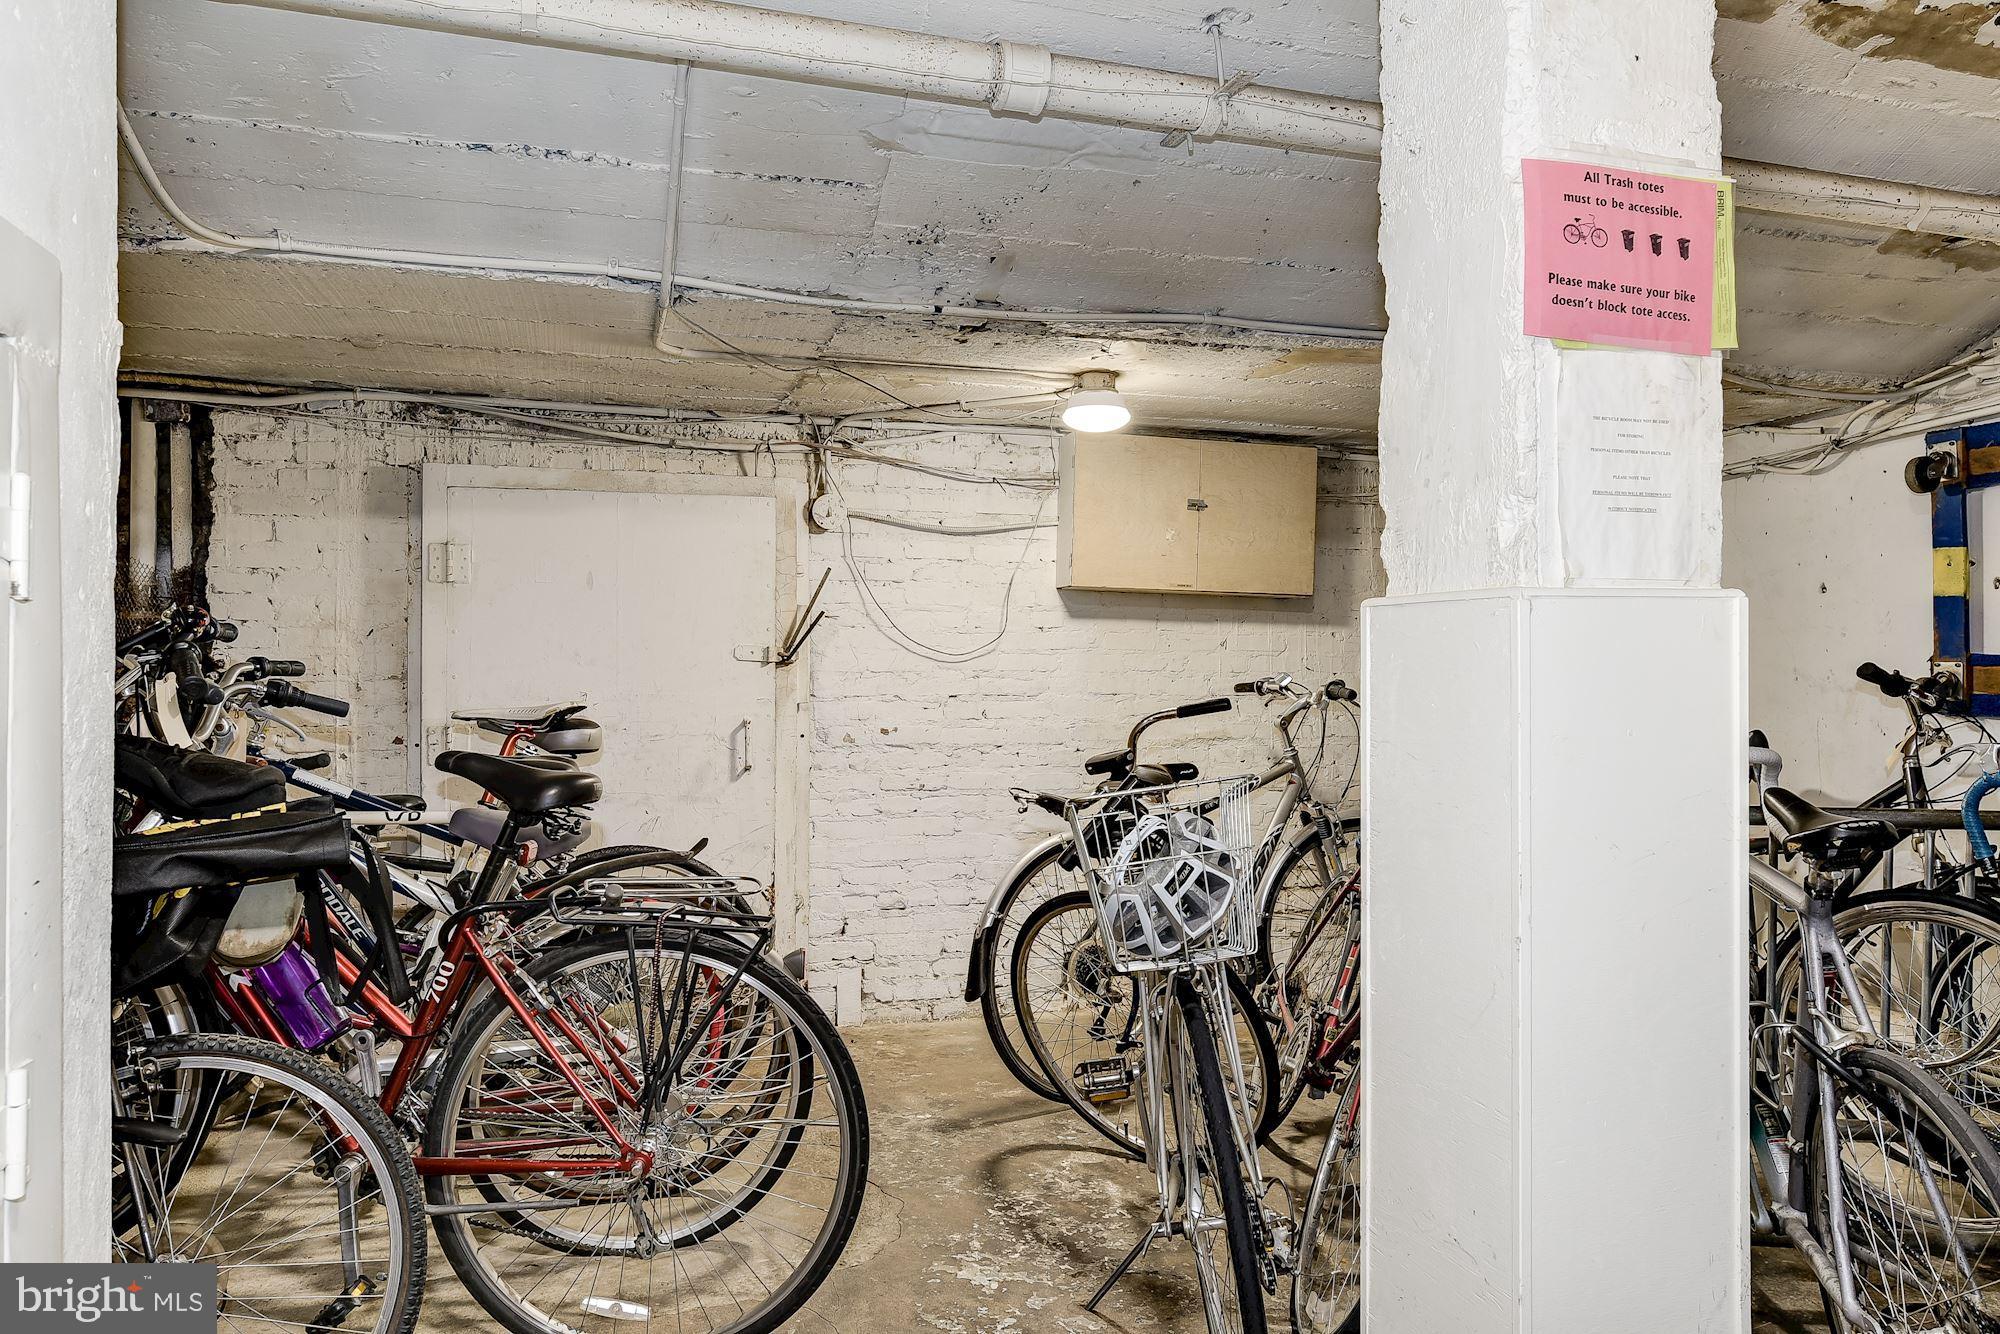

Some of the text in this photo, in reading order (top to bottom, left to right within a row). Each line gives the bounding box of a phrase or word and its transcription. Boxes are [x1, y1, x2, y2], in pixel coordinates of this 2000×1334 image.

[1584, 172, 1664, 193] All Trash totes
[1564, 194, 1682, 218] must to be accessible.
[1549, 273, 1695, 302] Please make sure your bike
[1552, 294, 1690, 321] doesn't block tote access.
[425, 960, 456, 1004] 700
